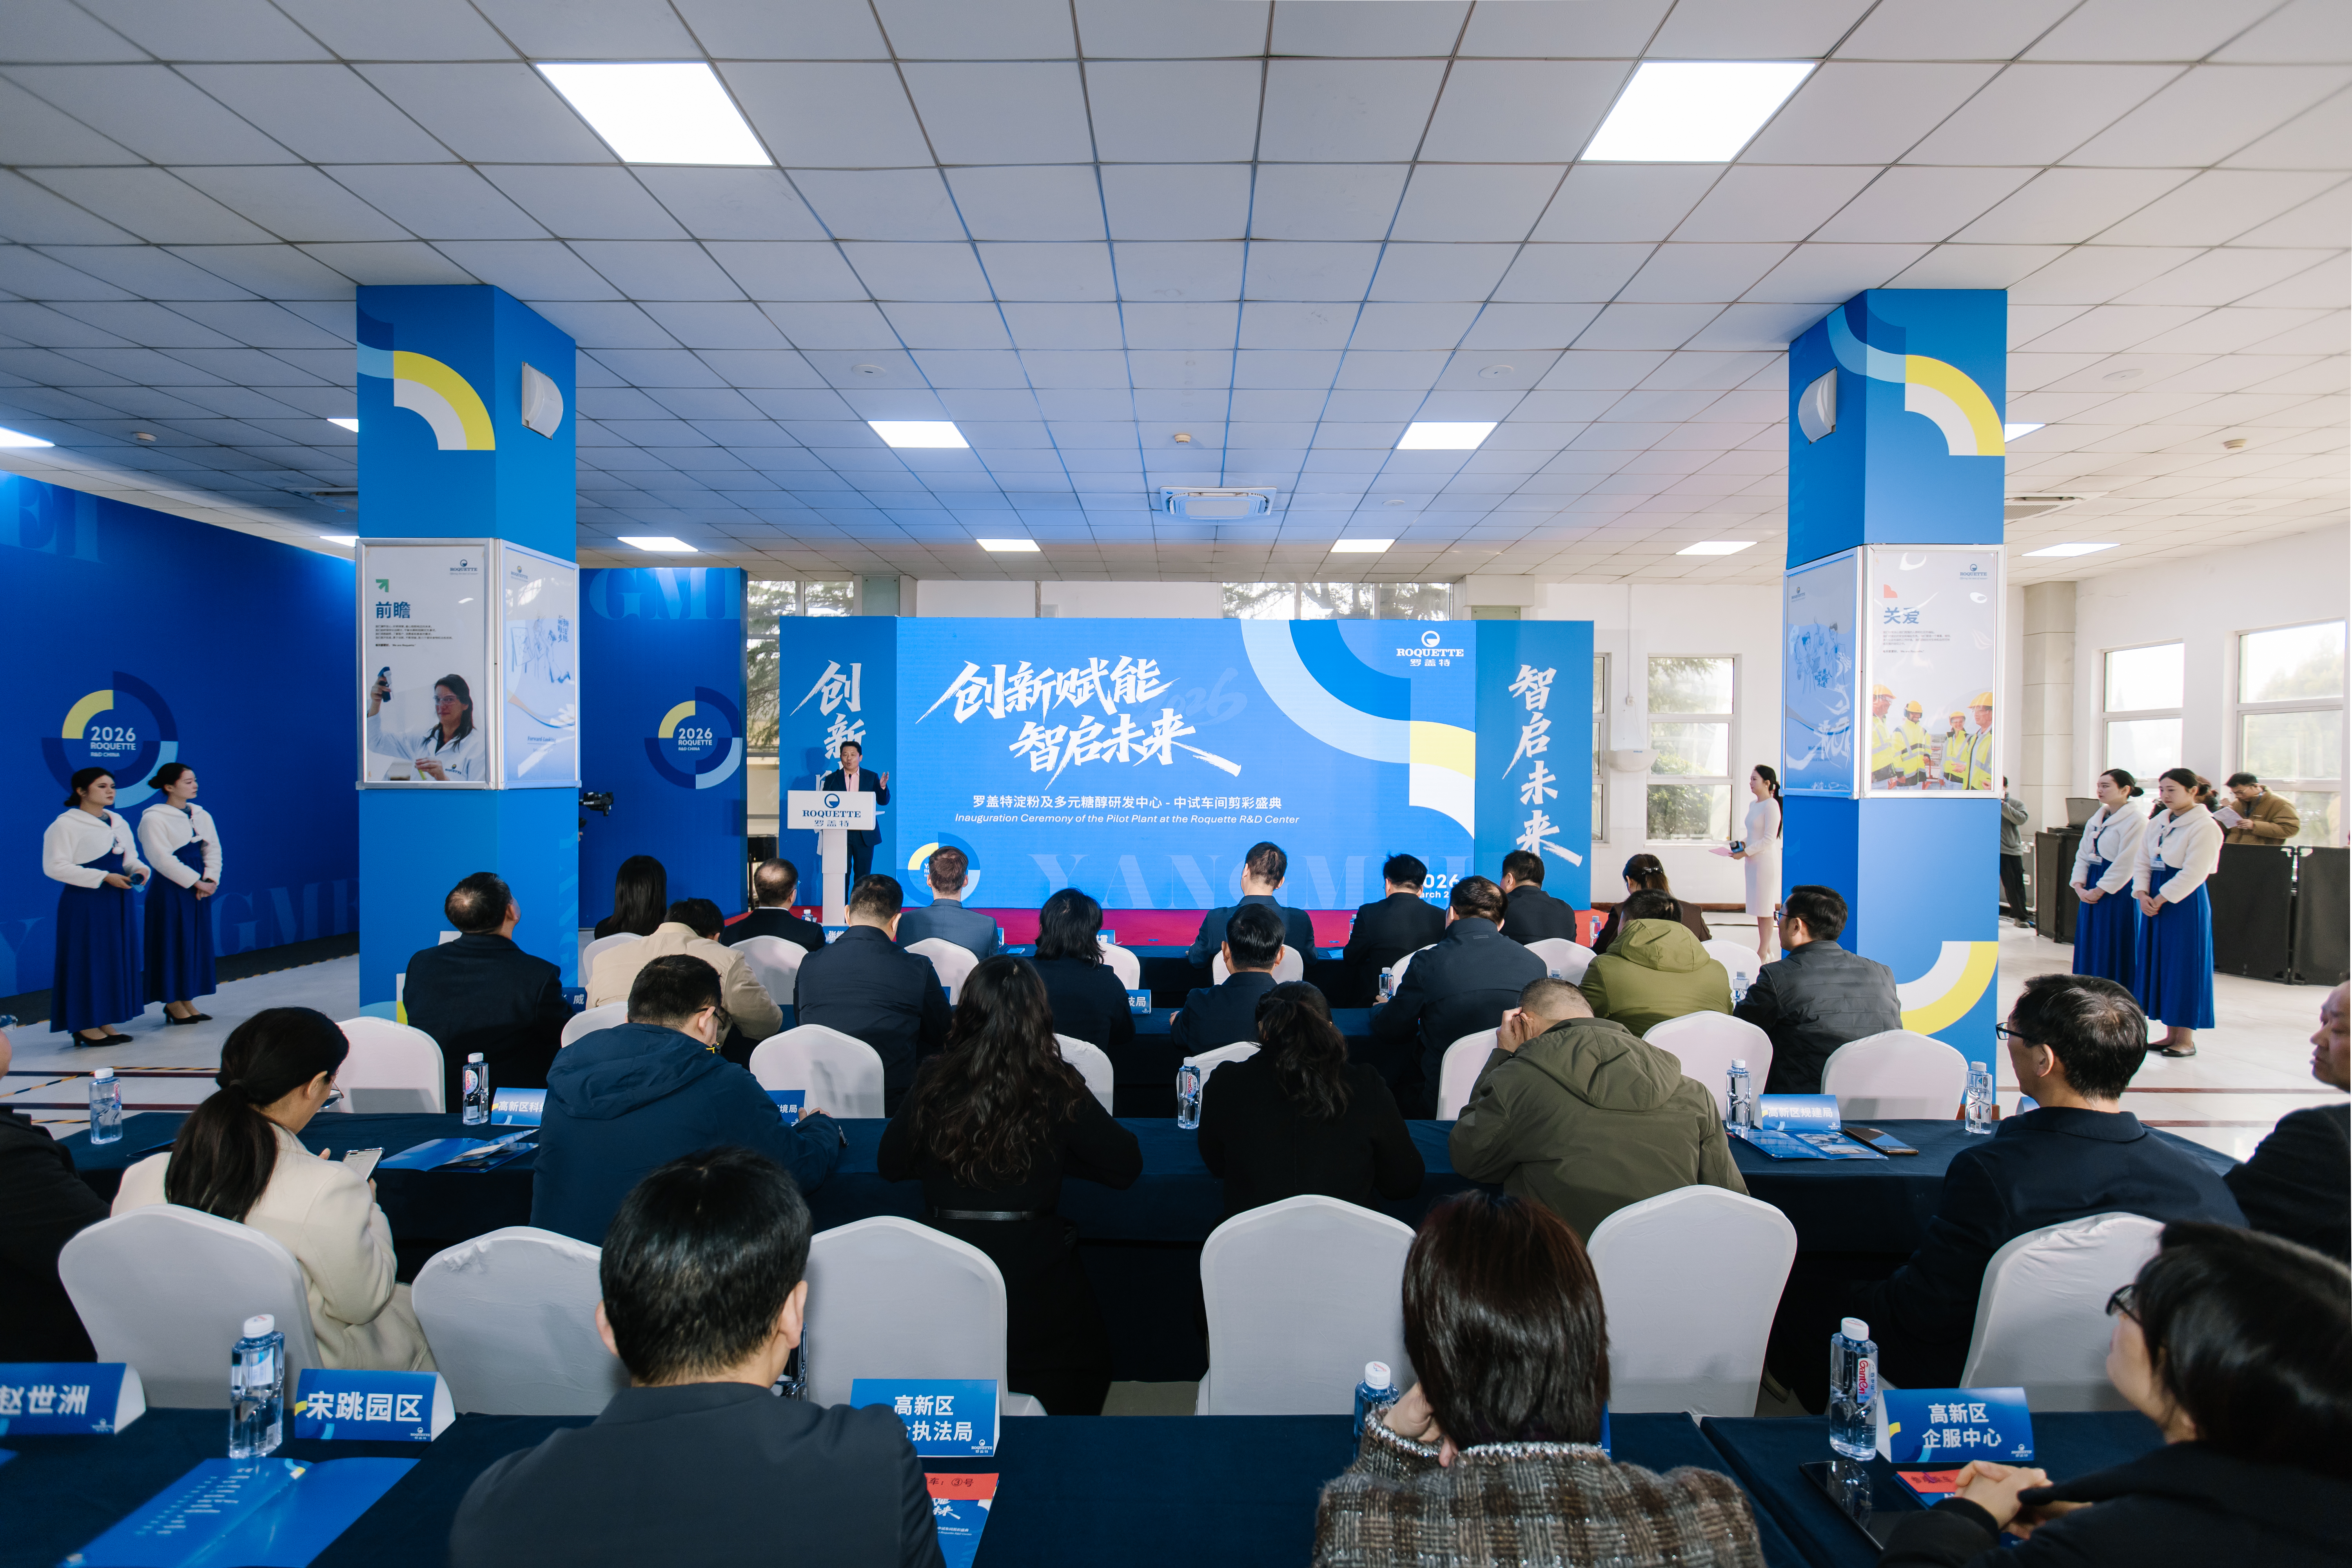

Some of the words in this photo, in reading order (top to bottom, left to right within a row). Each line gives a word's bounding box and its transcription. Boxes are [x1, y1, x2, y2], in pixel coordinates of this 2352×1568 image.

[376, 601, 411, 619] 前瞻
[1884, 607, 1920, 624] 关爱
[1396, 648, 1464, 658] ROQUETTE
[915, 655, 1181, 724] 创新赋能
[91, 726, 136, 742] 2026
[679, 728, 713, 739] 2026
[90, 742, 136, 750] ROQUETTE
[1009, 708, 1241, 790] 智启未来
[1502, 664, 1583, 867] 智启未来
[973, 795, 1162, 809] 罗盖特淀粉及多元糖醇研发中心
[1174, 796, 1282, 809] 中试车间剪彩盛典
[802, 810, 861, 818] ROQUETTE
[955, 813, 1018, 824] Inauguration
[1020, 814, 1073, 824] Ceremony
[1075, 814, 1087, 822] of
[1191, 815, 1237, 825] Roquette
[1265, 815, 1300, 824] Center
[1423, 874, 1460, 889] 026
[777, 1104, 797, 1113] 境局
[1768, 1107, 1833, 1118] 高新区规建局
[306, 1390, 423, 1422] 宋跳园区
[894, 1395, 955, 1416] 高新区
[1928, 1403, 1989, 1424] 高新区
[907, 1421, 973, 1442] 执法局
[1922, 1428, 2002, 1448] 企服中心
